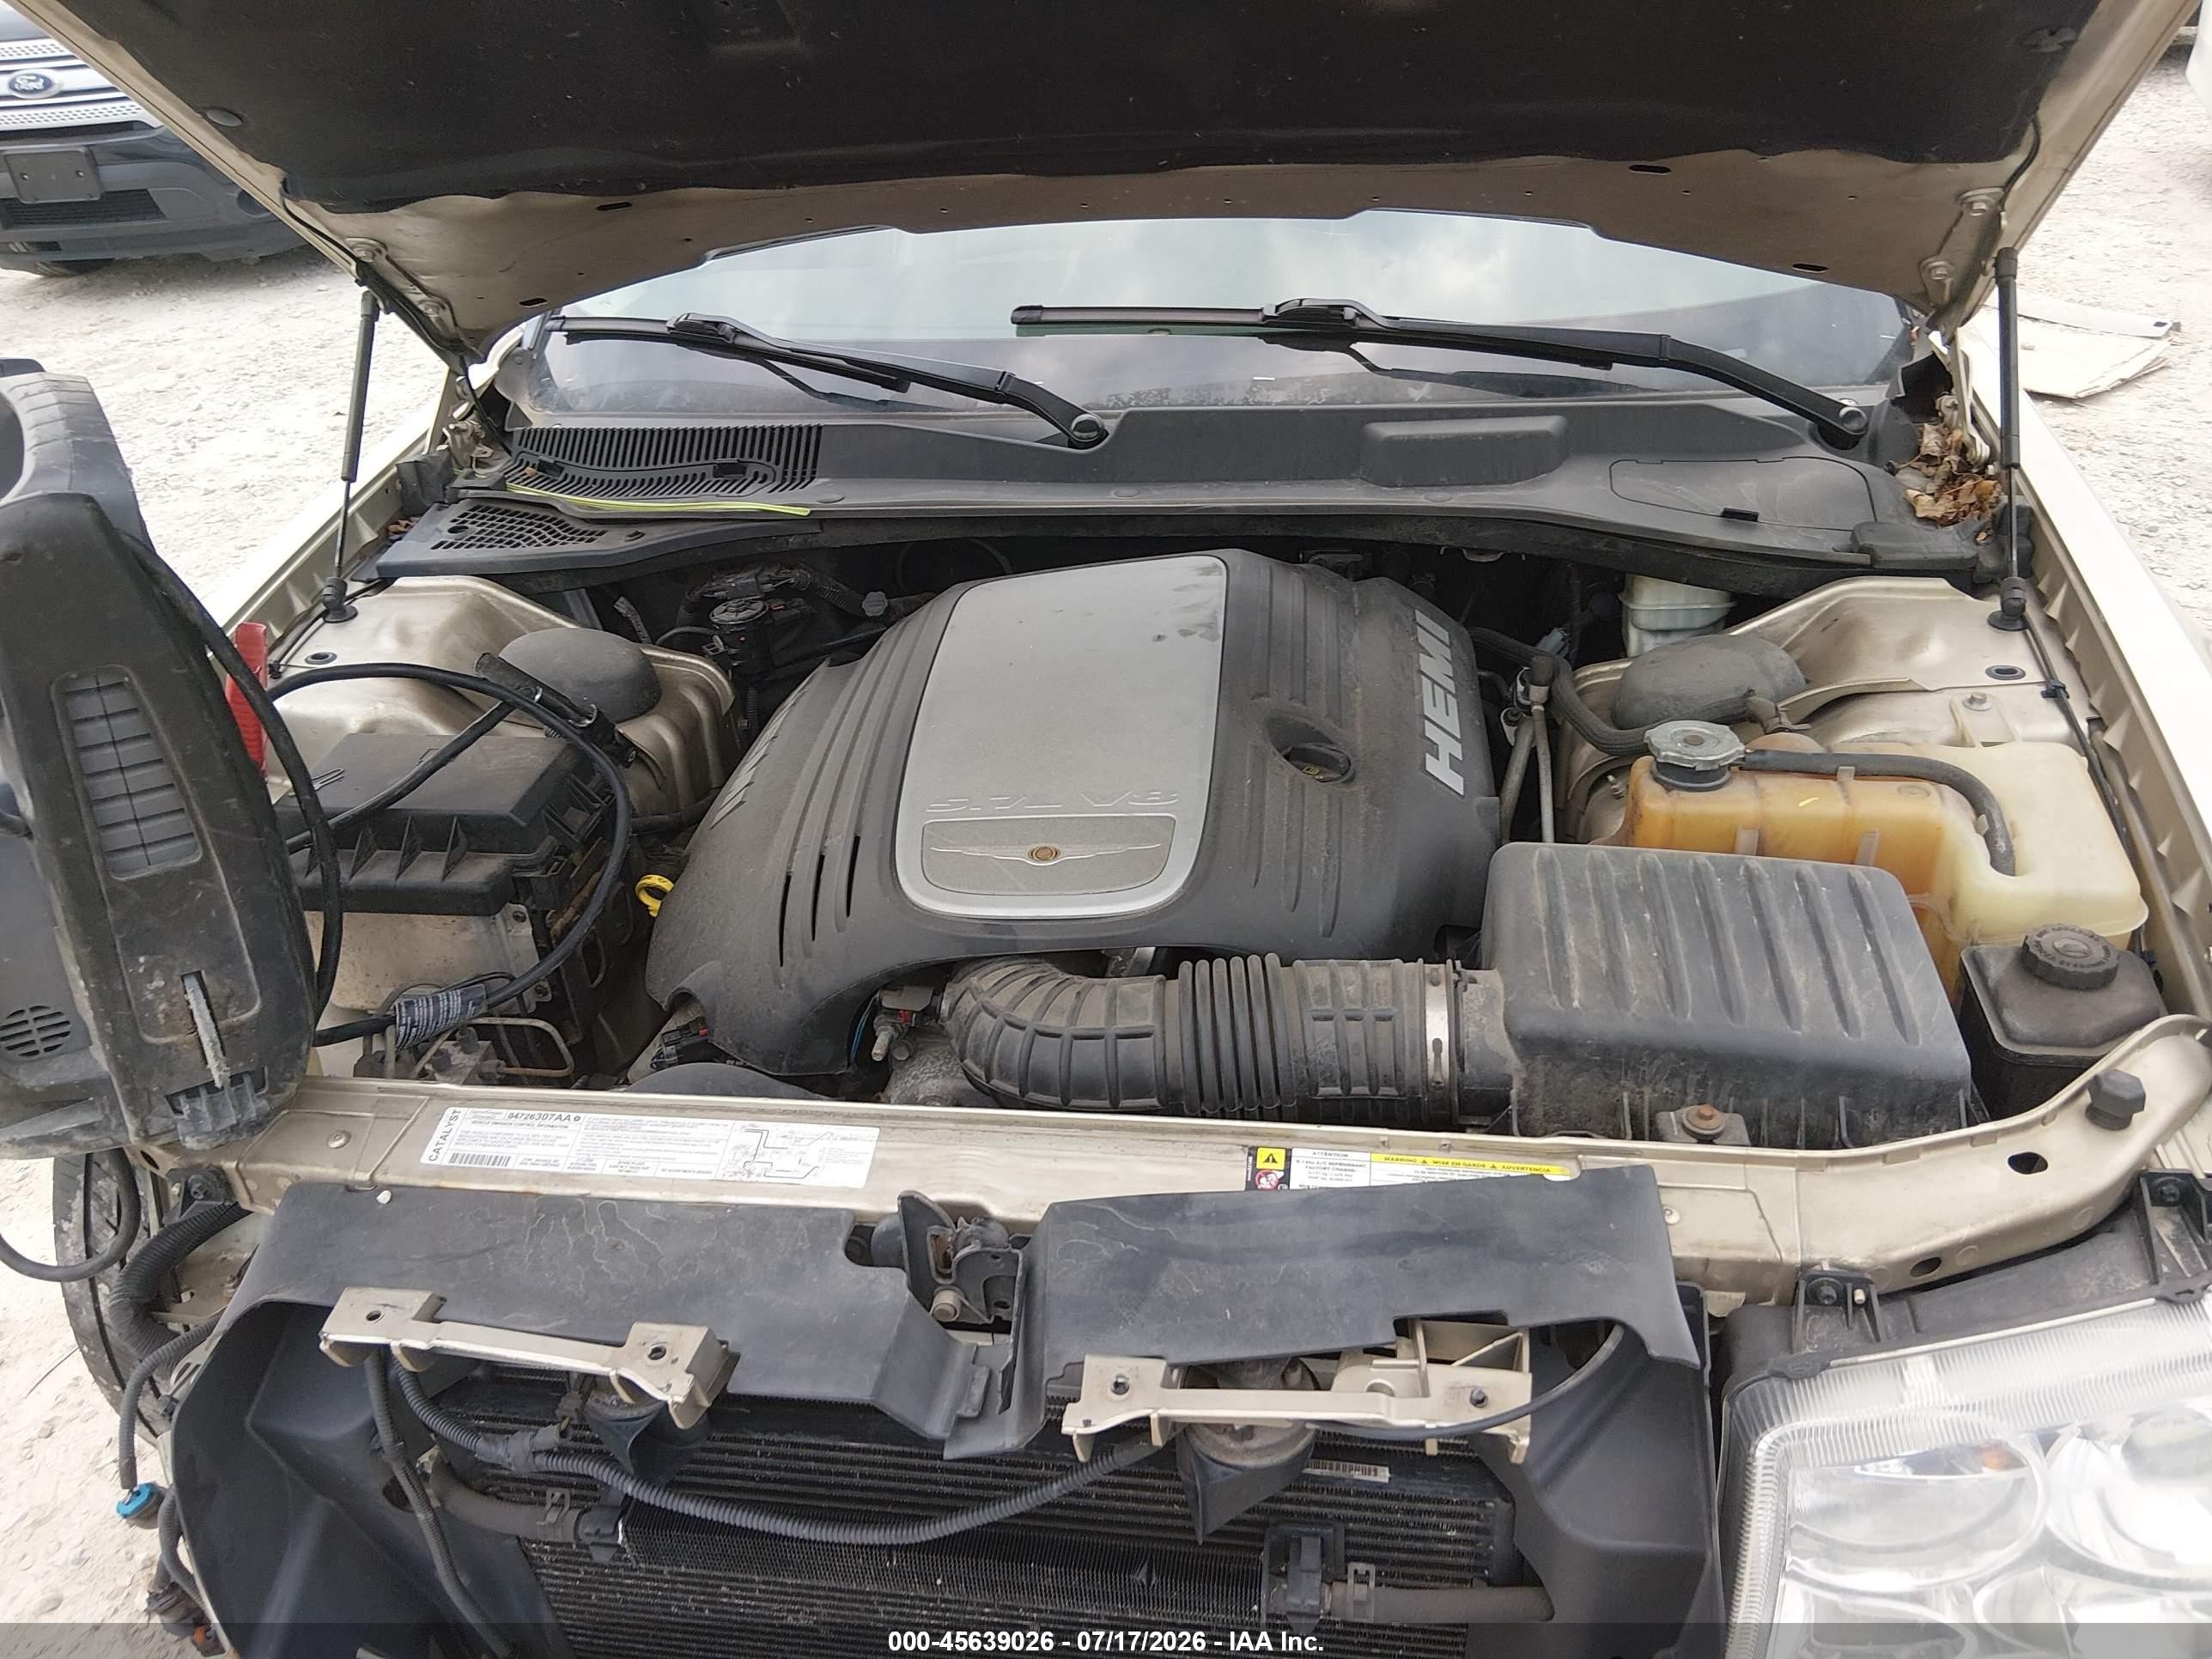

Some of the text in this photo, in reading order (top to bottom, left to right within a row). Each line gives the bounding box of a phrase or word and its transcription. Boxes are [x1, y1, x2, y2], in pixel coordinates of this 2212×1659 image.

[1415, 610, 1464, 795] HEMI
[428, 1109, 461, 1162] CATALYST
[1502, 1164, 1552, 1173] ADVERTENCIA
